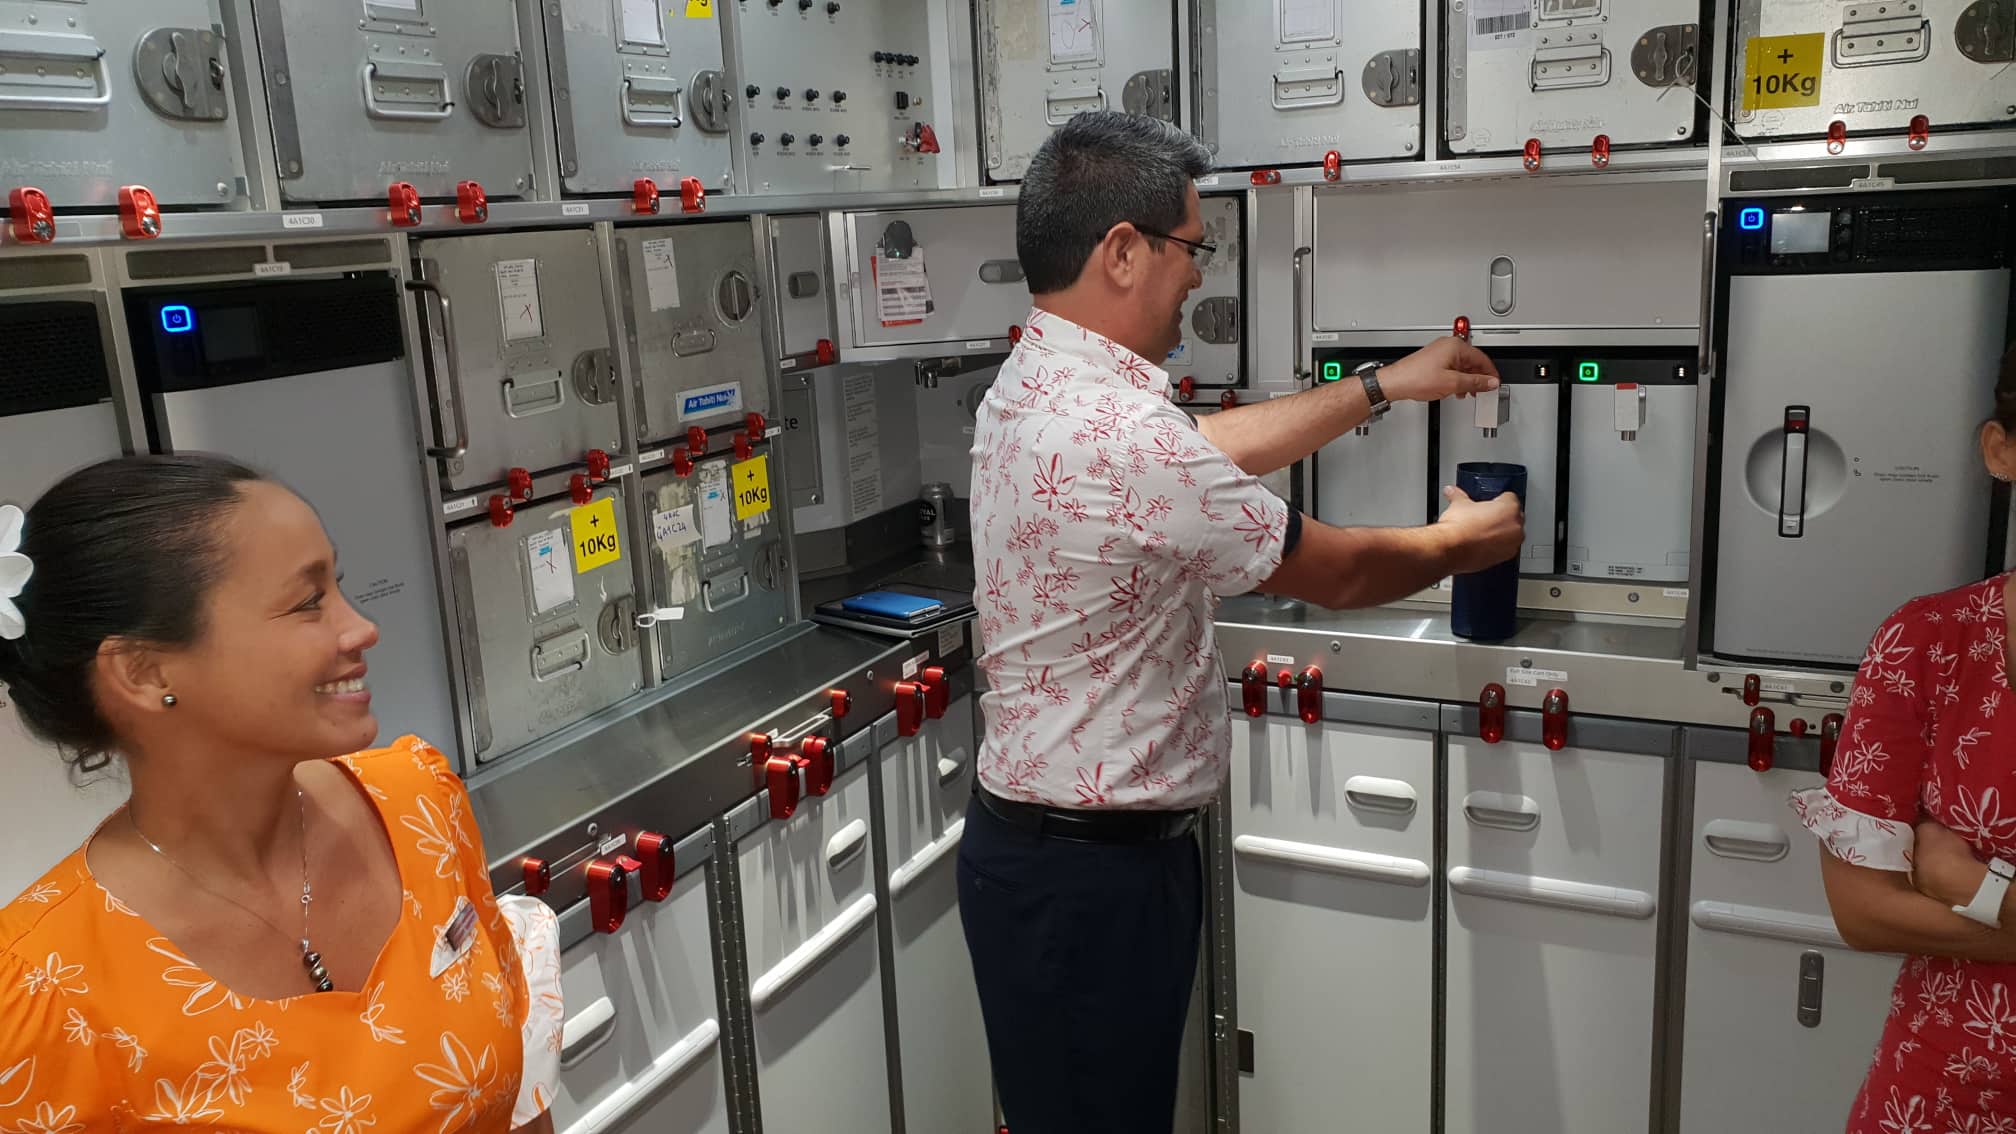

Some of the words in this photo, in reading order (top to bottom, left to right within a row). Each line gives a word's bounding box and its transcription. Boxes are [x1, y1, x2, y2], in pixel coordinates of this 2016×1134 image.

[1752, 72, 1817, 97] 10Kg
[1833, 103, 1856, 115] Air
[1893, 98, 1919, 110] Nui
[688, 398, 698, 409] Air
[698, 393, 716, 407] Tahiti
[739, 485, 768, 507] 10Kg
[579, 533, 617, 558] 10Kg
